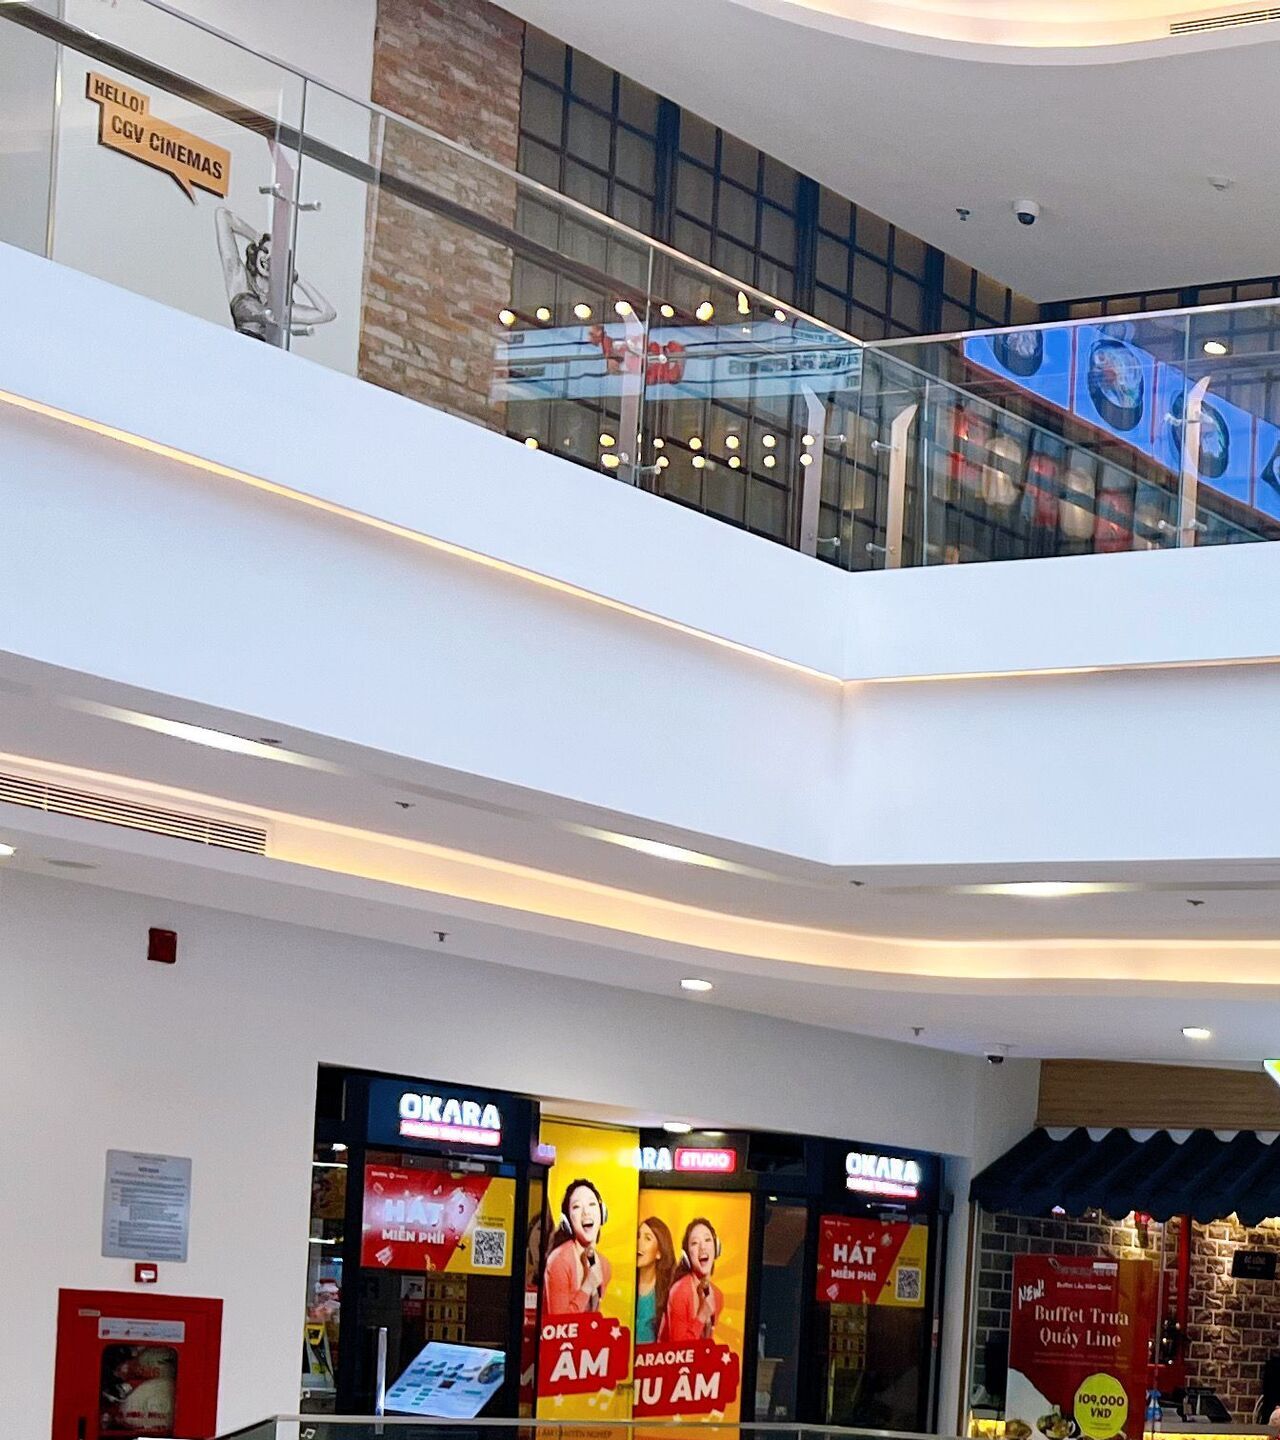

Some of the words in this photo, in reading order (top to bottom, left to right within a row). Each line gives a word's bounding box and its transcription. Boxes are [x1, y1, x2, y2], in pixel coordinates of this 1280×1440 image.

[94, 79, 145, 115] HELLO!
[111, 115, 145, 143] CGV
[149, 132, 222, 179] CINEMAS
[399, 1092, 500, 1130] OKARA
[681, 1151, 731, 1169] STUDIO
[846, 1152, 921, 1184] OKARA
[833, 1240, 877, 1265] HÁT
[1034, 1304, 1085, 1324] Buffet
[1090, 1307, 1129, 1326] Trưa
[540, 1322, 579, 1341] OKE
[1086, 1330, 1122, 1348] Line
[549, 1342, 610, 1383] ÂM
[669, 1366, 722, 1404] ÂM
[1090, 1407, 1112, 1418] VND
